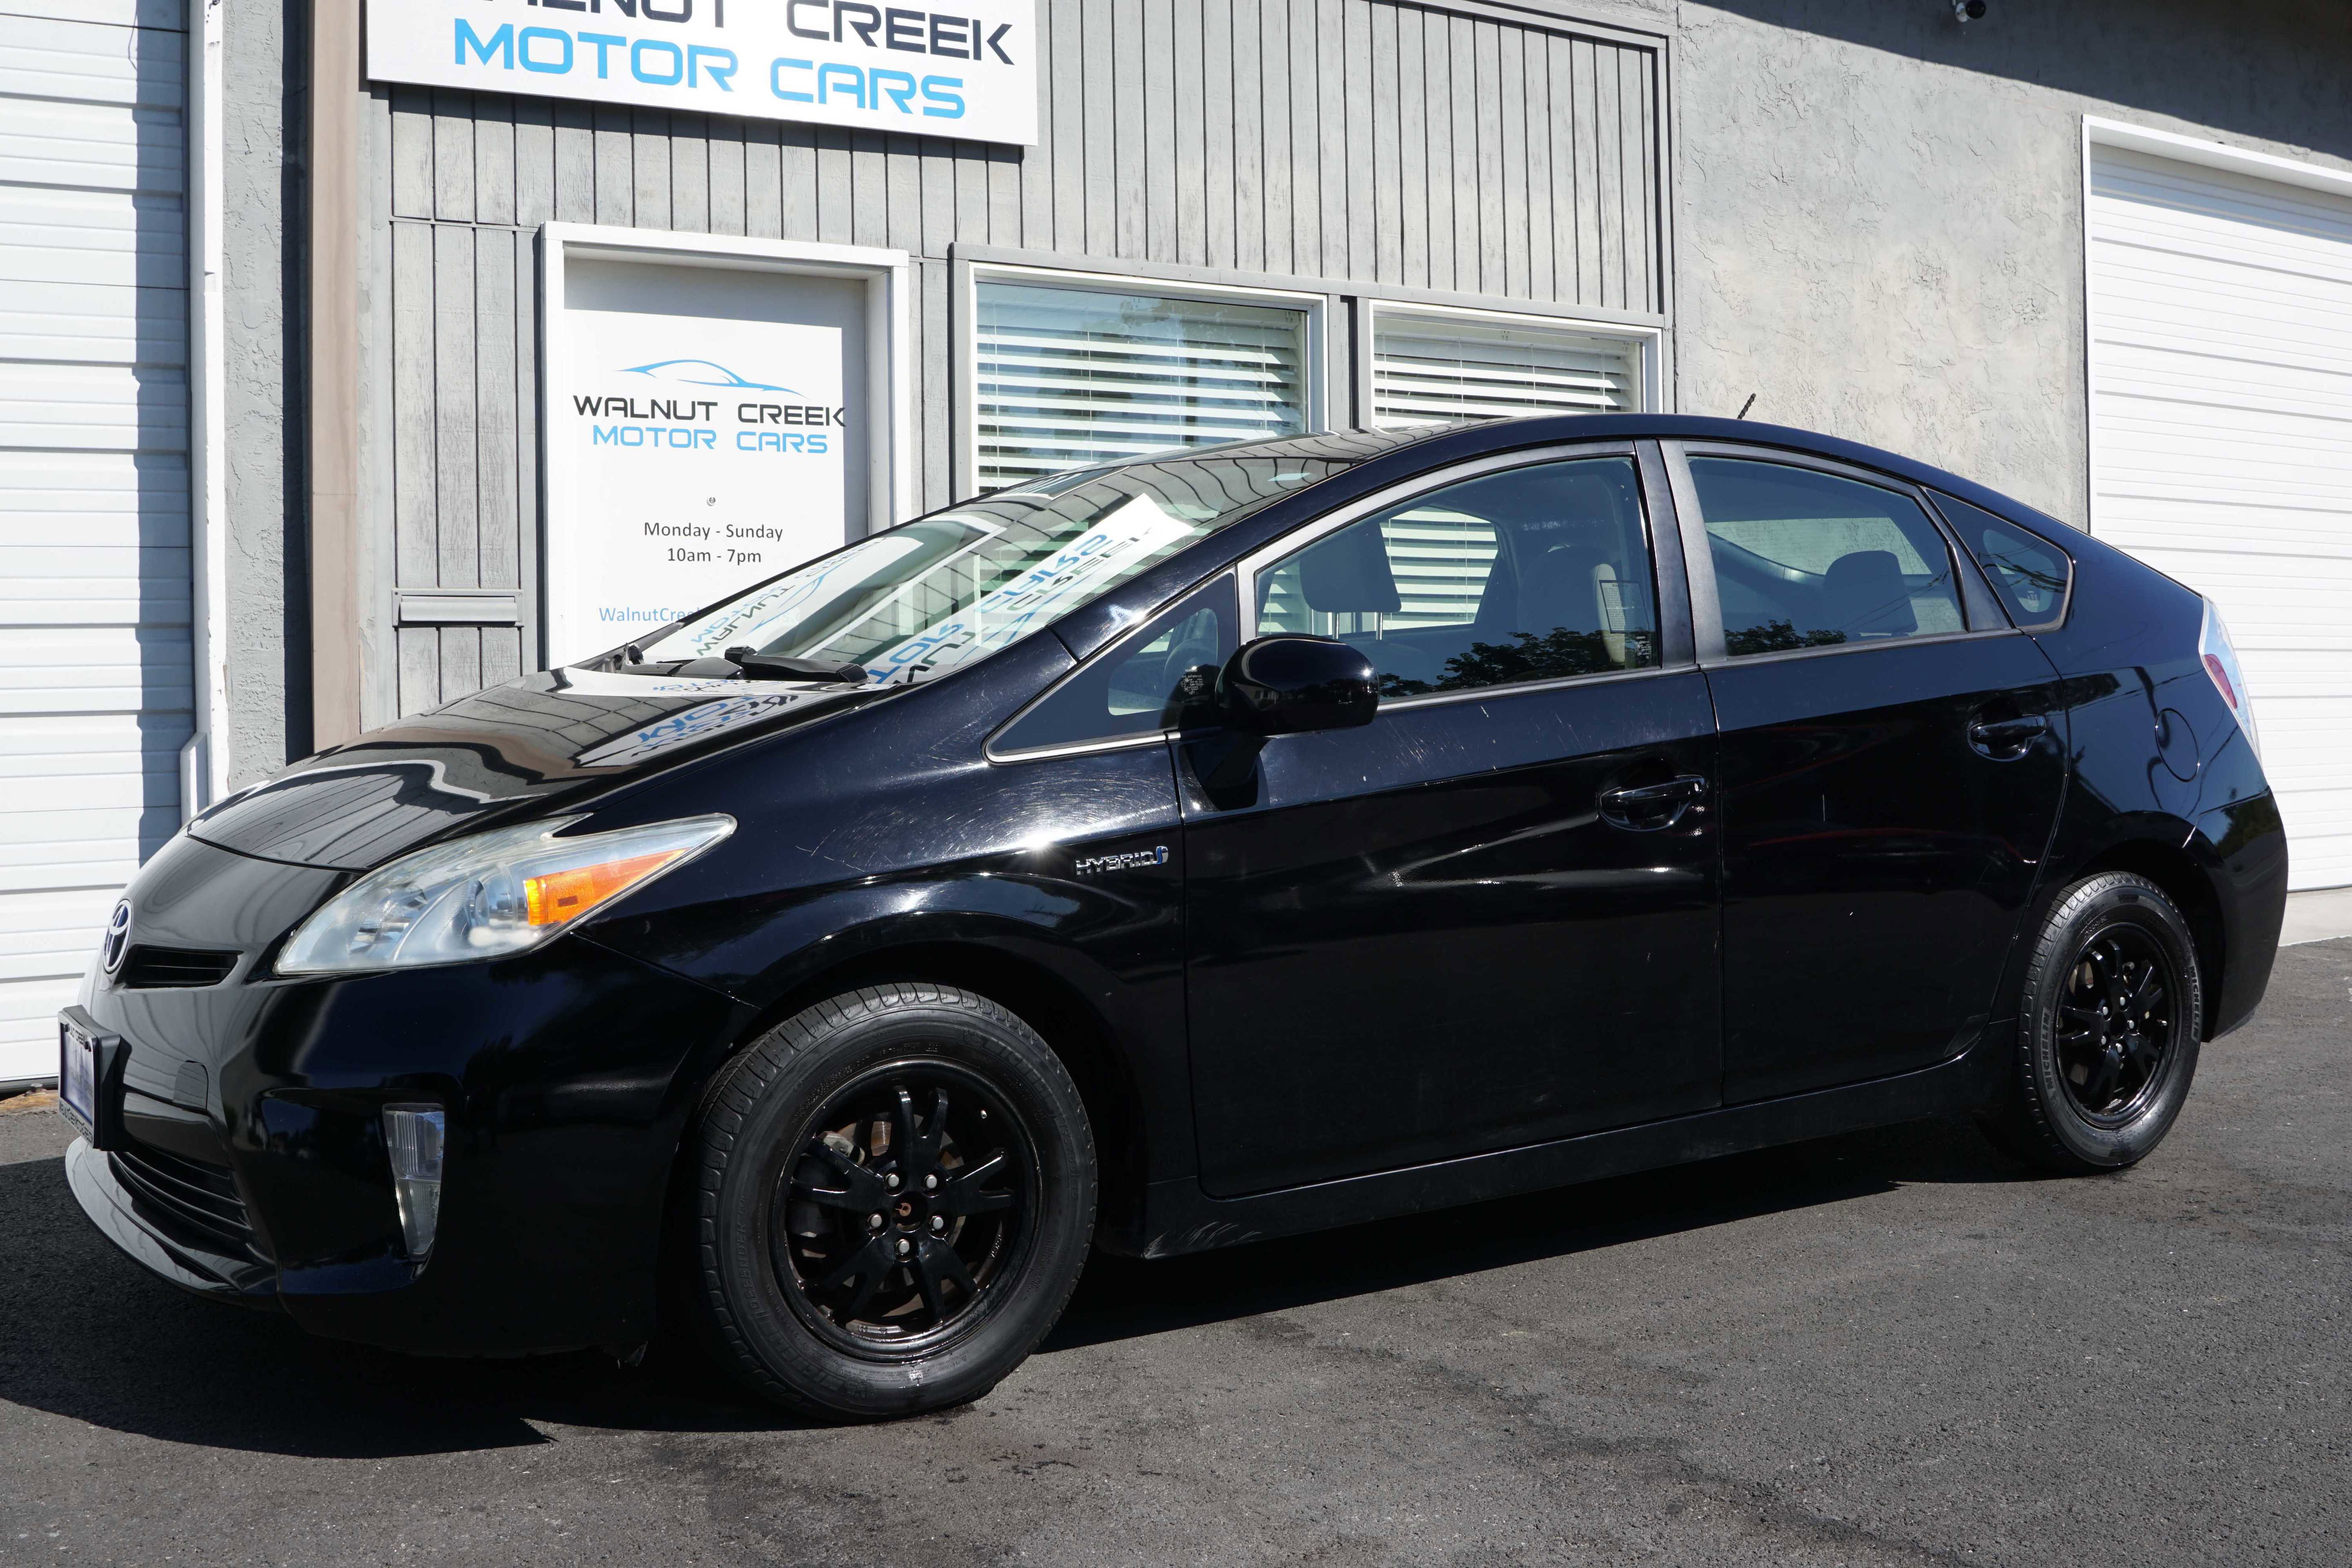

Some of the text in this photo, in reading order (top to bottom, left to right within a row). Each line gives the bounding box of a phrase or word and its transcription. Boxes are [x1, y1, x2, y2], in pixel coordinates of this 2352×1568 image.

[786, 0, 1015, 66] CREEK
[454, 18, 965, 119] MOTOR CARS
[573, 395, 846, 428] WALNUT CREEK
[593, 425, 828, 454] MOTOR CARS
[644, 523, 711, 541] Monday
[726, 524, 783, 542] Sunday
[668, 548, 711, 562] 10am
[727, 550, 762, 565] 7pm
[599, 607, 699, 621] WalnutCre
[1075, 851, 1154, 875] HYBRID
[2189, 965, 2200, 1039] MICHELIN
[2042, 1011, 2055, 1090] MICHELIN
